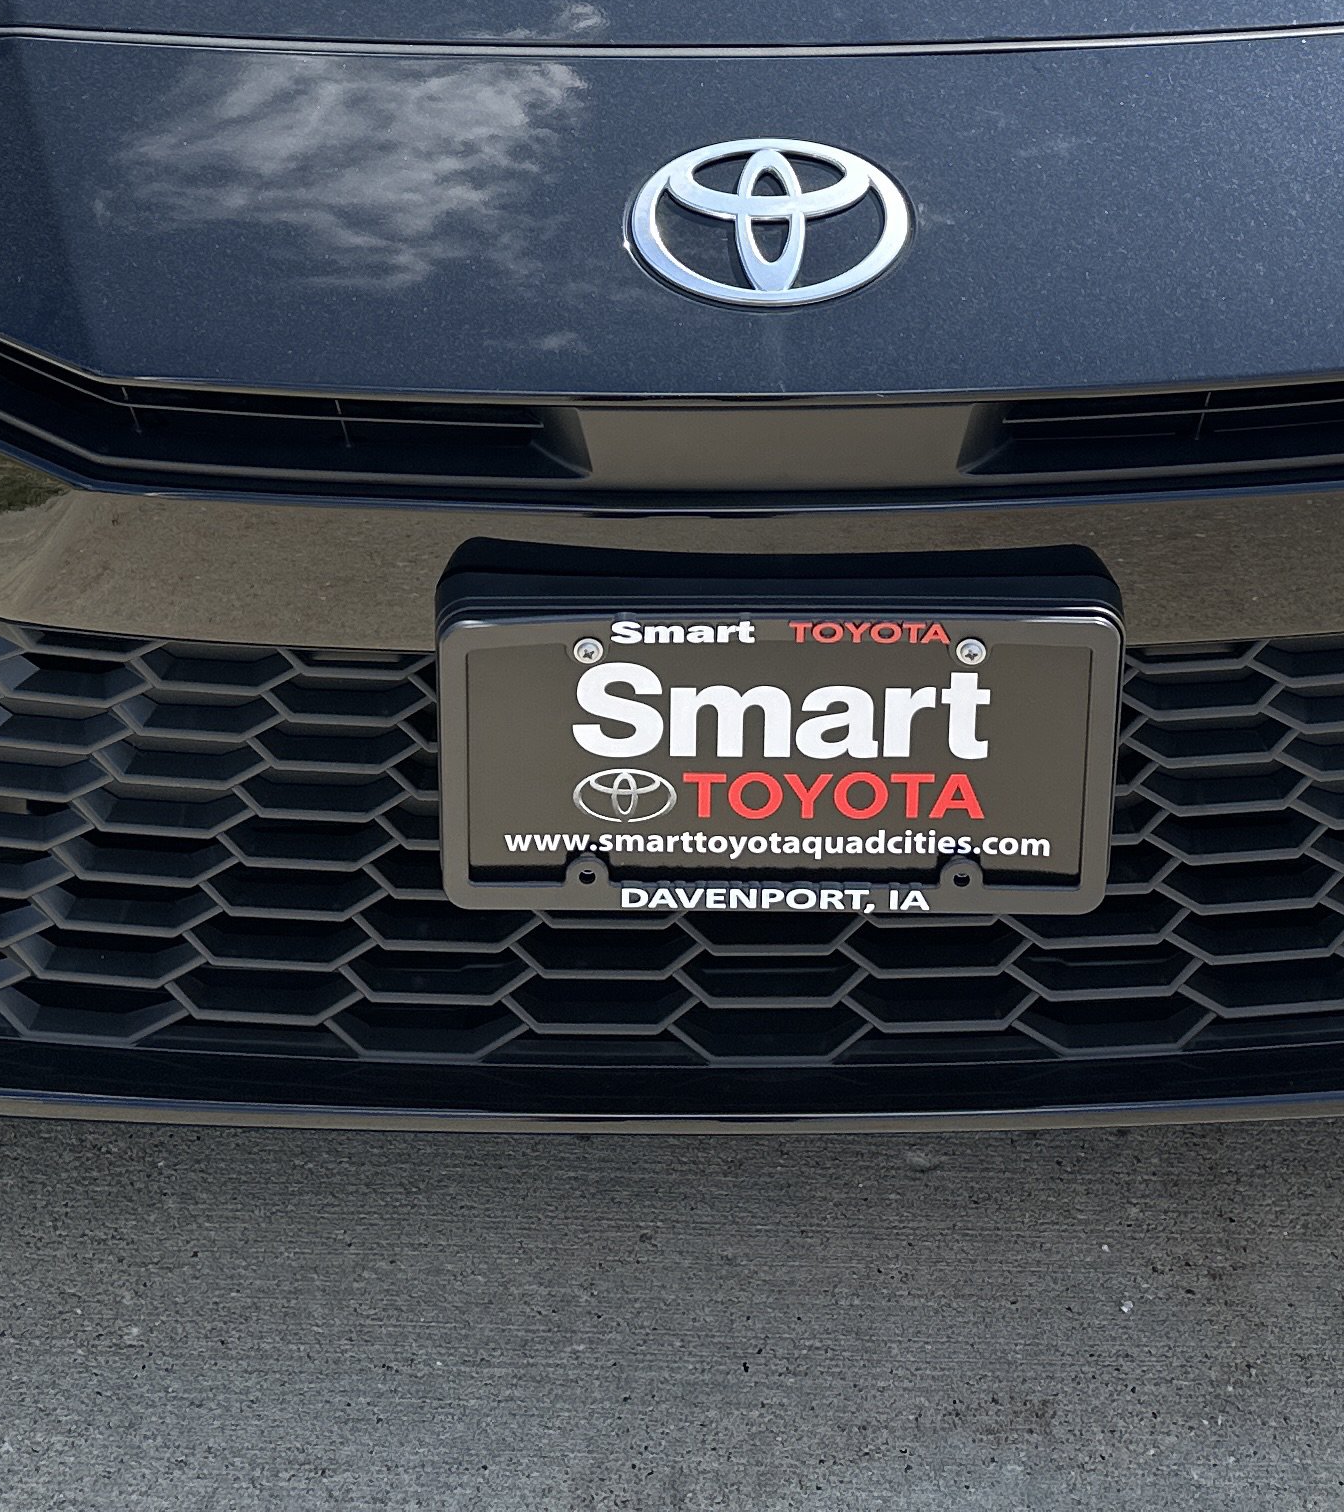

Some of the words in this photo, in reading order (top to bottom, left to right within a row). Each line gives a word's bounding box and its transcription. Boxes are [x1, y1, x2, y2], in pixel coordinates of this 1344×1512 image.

[610, 620, 756, 644] Smart
[789, 621, 951, 644] TOYOTA
[572, 662, 991, 759] Smart
[682, 771, 985, 819] TOYOTA
[504, 829, 1050, 860] www.smarttoyotaquadcities.com
[621, 888, 875, 913] DAVENPORT,
[889, 890, 930, 910] IA
